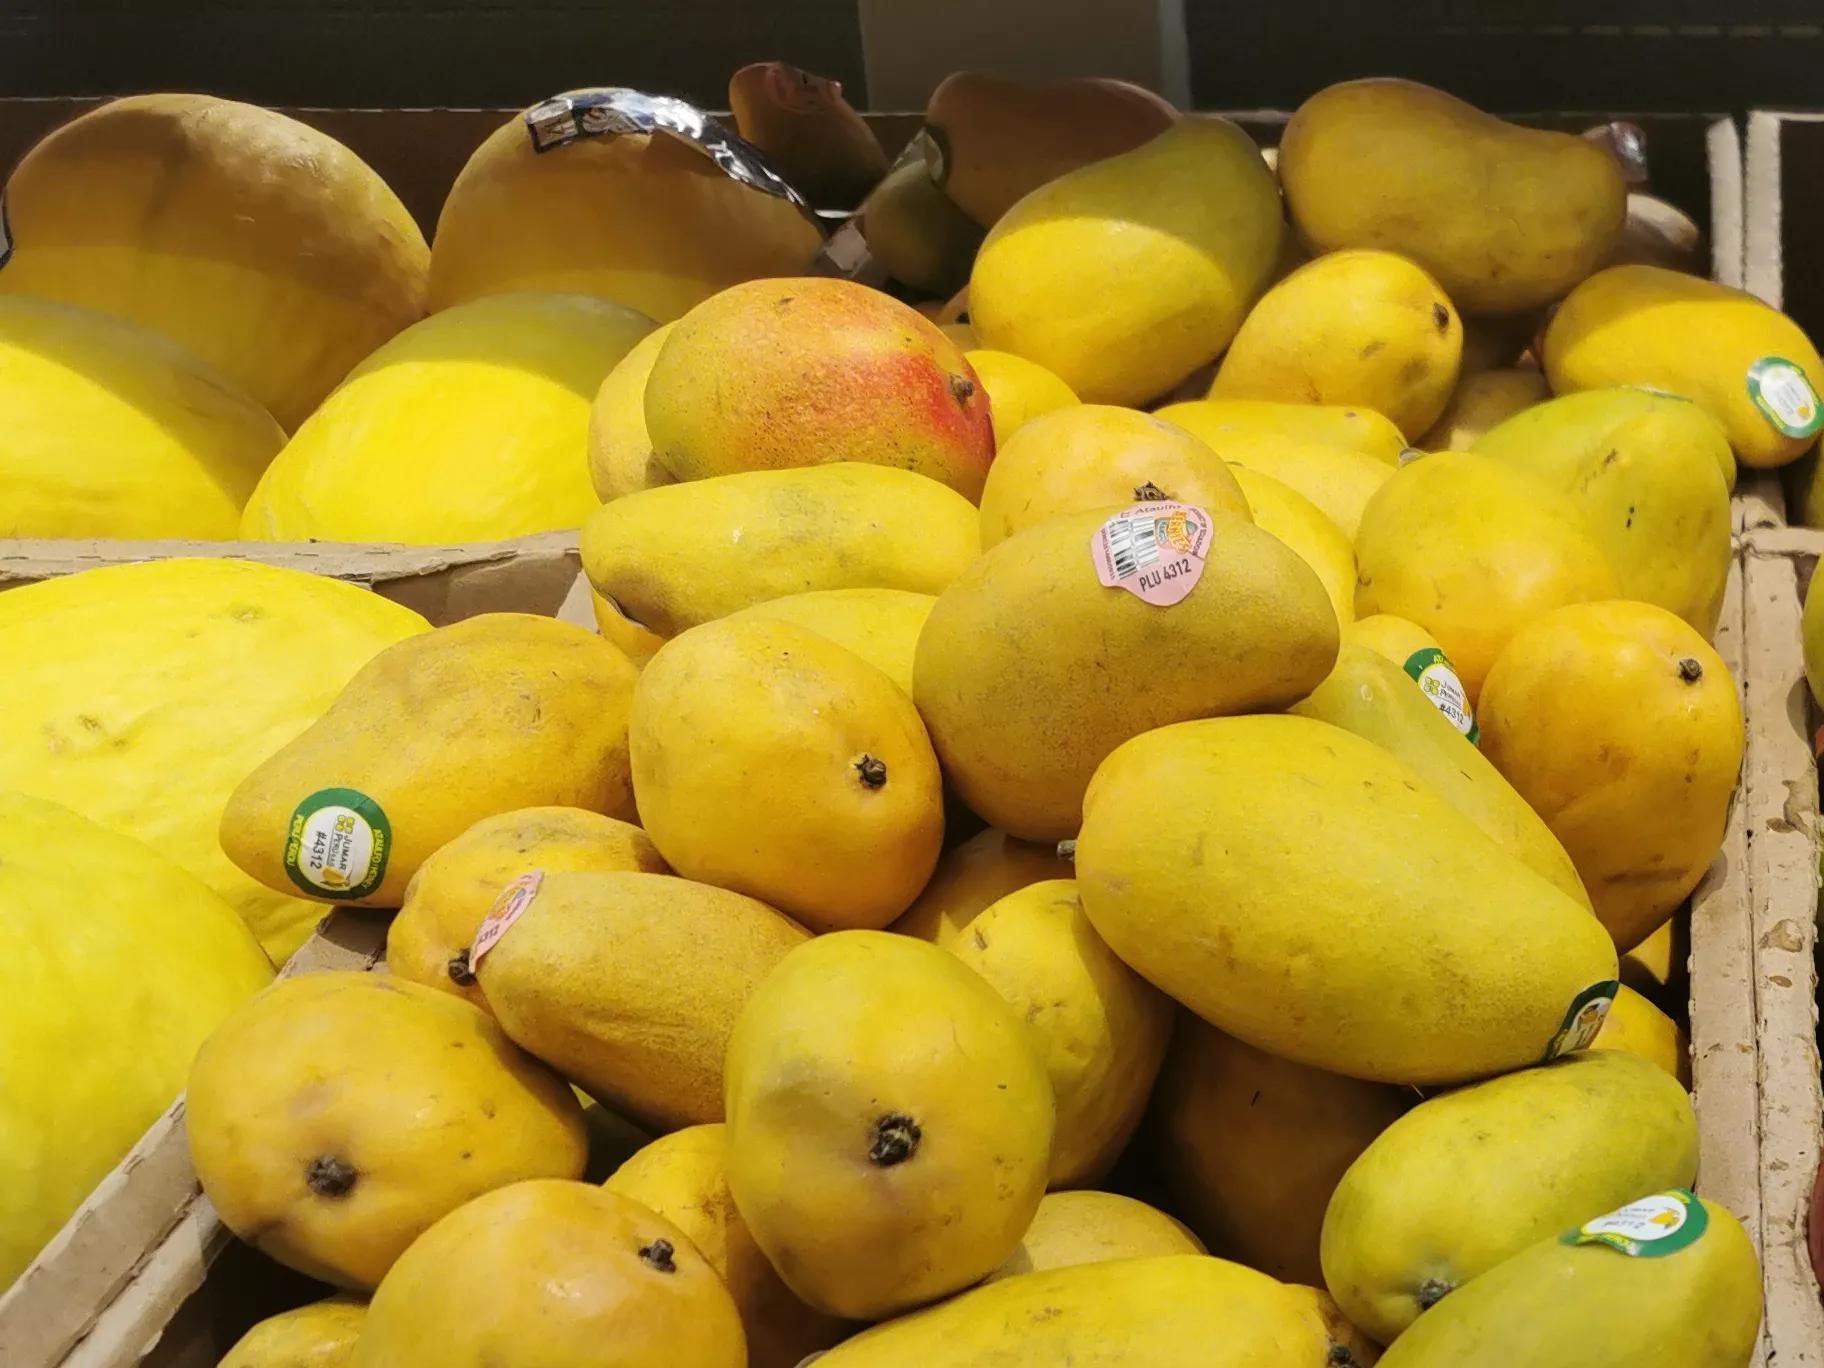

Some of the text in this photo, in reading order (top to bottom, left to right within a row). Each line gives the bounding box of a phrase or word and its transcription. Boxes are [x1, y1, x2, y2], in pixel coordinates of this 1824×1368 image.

[1139, 558, 1192, 593] PLU 4312
[310, 830, 328, 870] #4312
[339, 834, 353, 871] JUMAR
